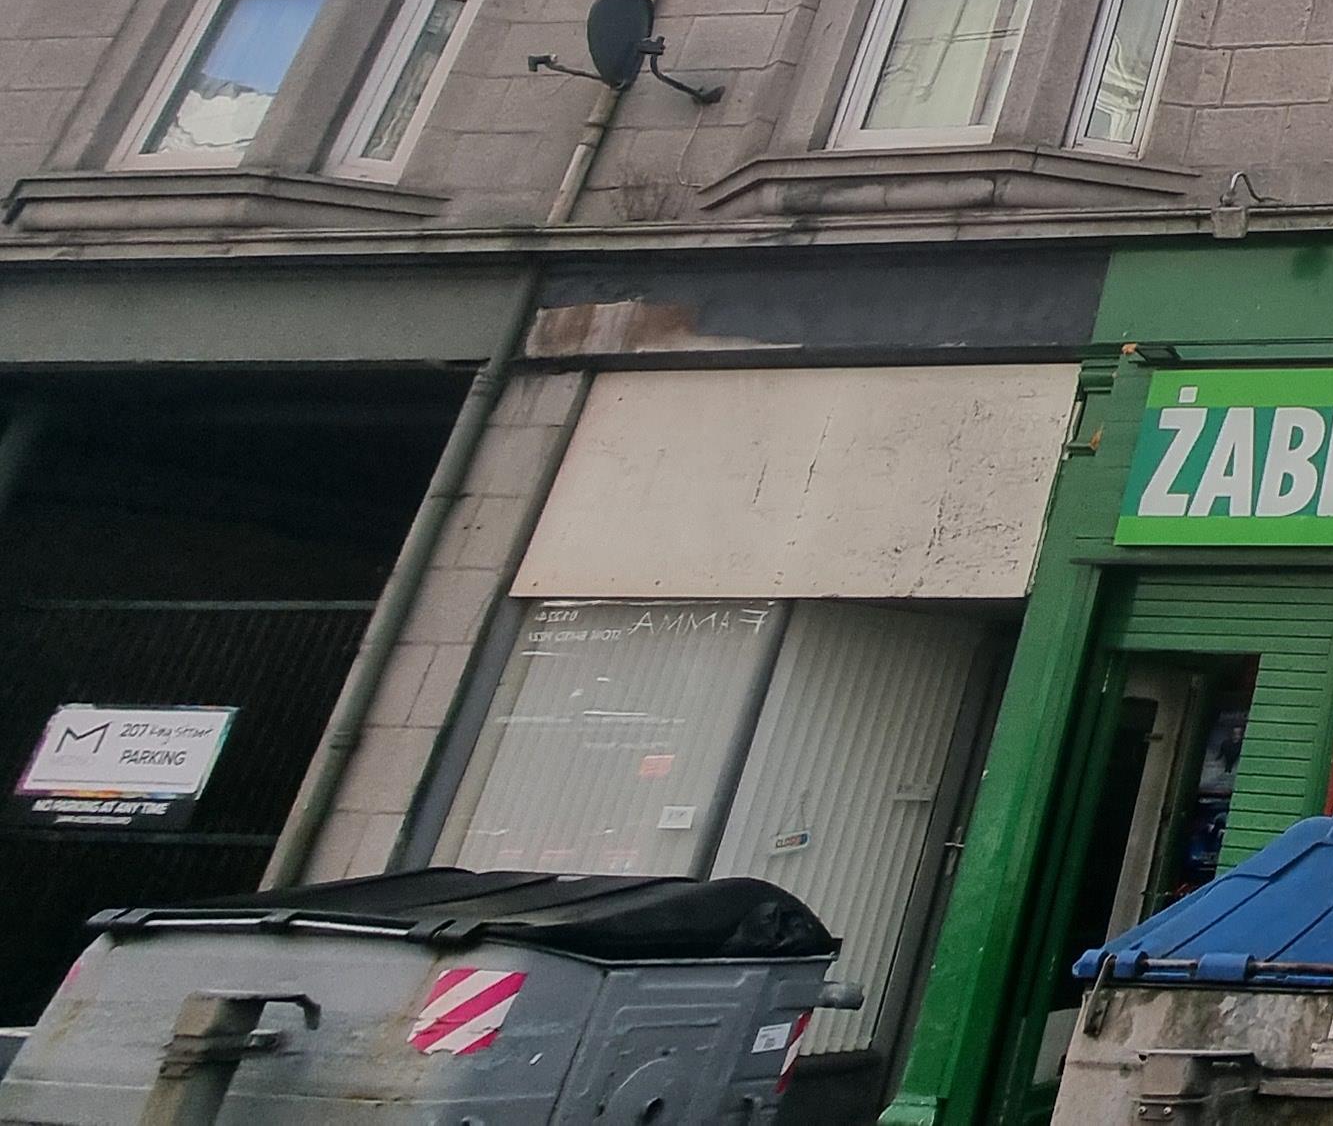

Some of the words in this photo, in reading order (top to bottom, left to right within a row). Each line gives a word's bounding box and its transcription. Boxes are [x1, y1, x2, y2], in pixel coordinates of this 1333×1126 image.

[119, 723, 150, 738] 207
[118, 750, 188, 766] PARKING
[32, 799, 52, 812] NO
